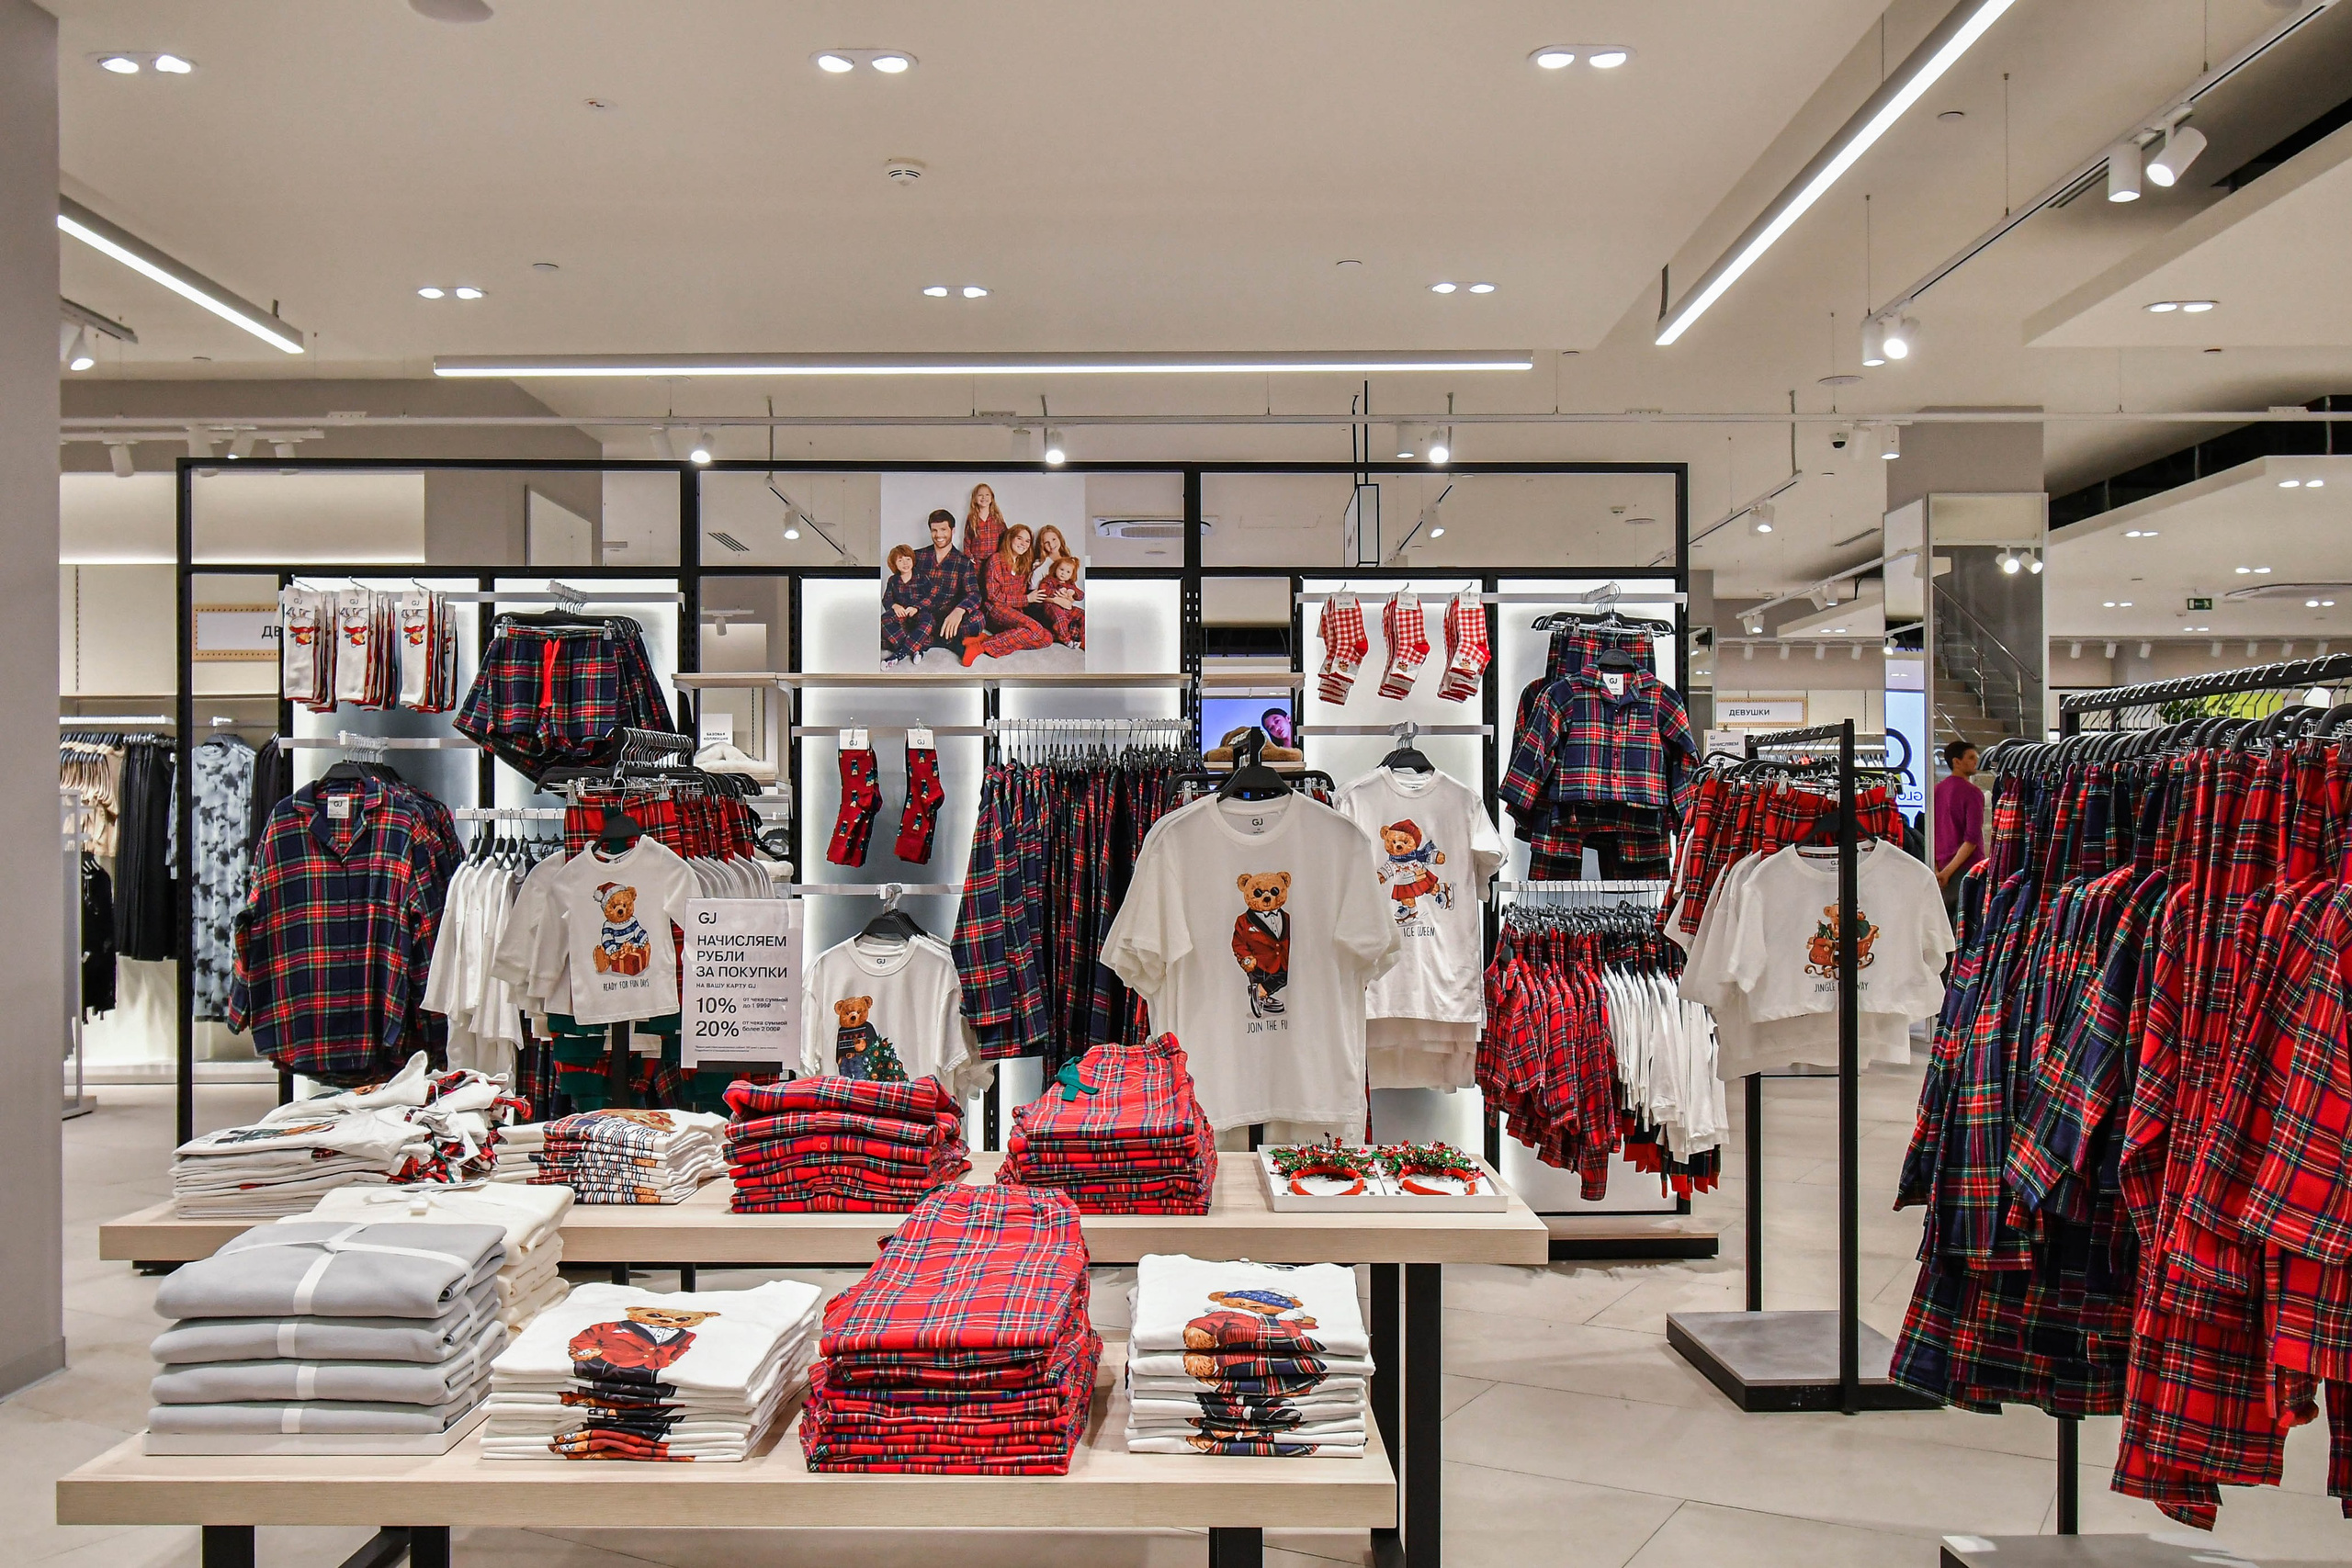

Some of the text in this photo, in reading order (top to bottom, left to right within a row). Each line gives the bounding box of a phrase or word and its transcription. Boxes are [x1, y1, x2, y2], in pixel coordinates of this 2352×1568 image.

[698, 912, 717, 924] GJ
[1403, 927, 1414, 937] ICE
[697, 935, 786, 947] НАЧИСЛЯЕМ
[697, 951, 744, 962] РУБЛИ
[696, 966, 787, 978] ЗА ПОКУПКИ
[603, 982, 617, 991] READY
[619, 981, 628, 989] FOR
[1815, 982, 1835, 992] JINGLE
[696, 997, 737, 1014] 10%
[695, 1021, 739, 1037] 20%
[1247, 1022, 1263, 1033] JOIN
[1266, 1020, 1277, 1030] THE
